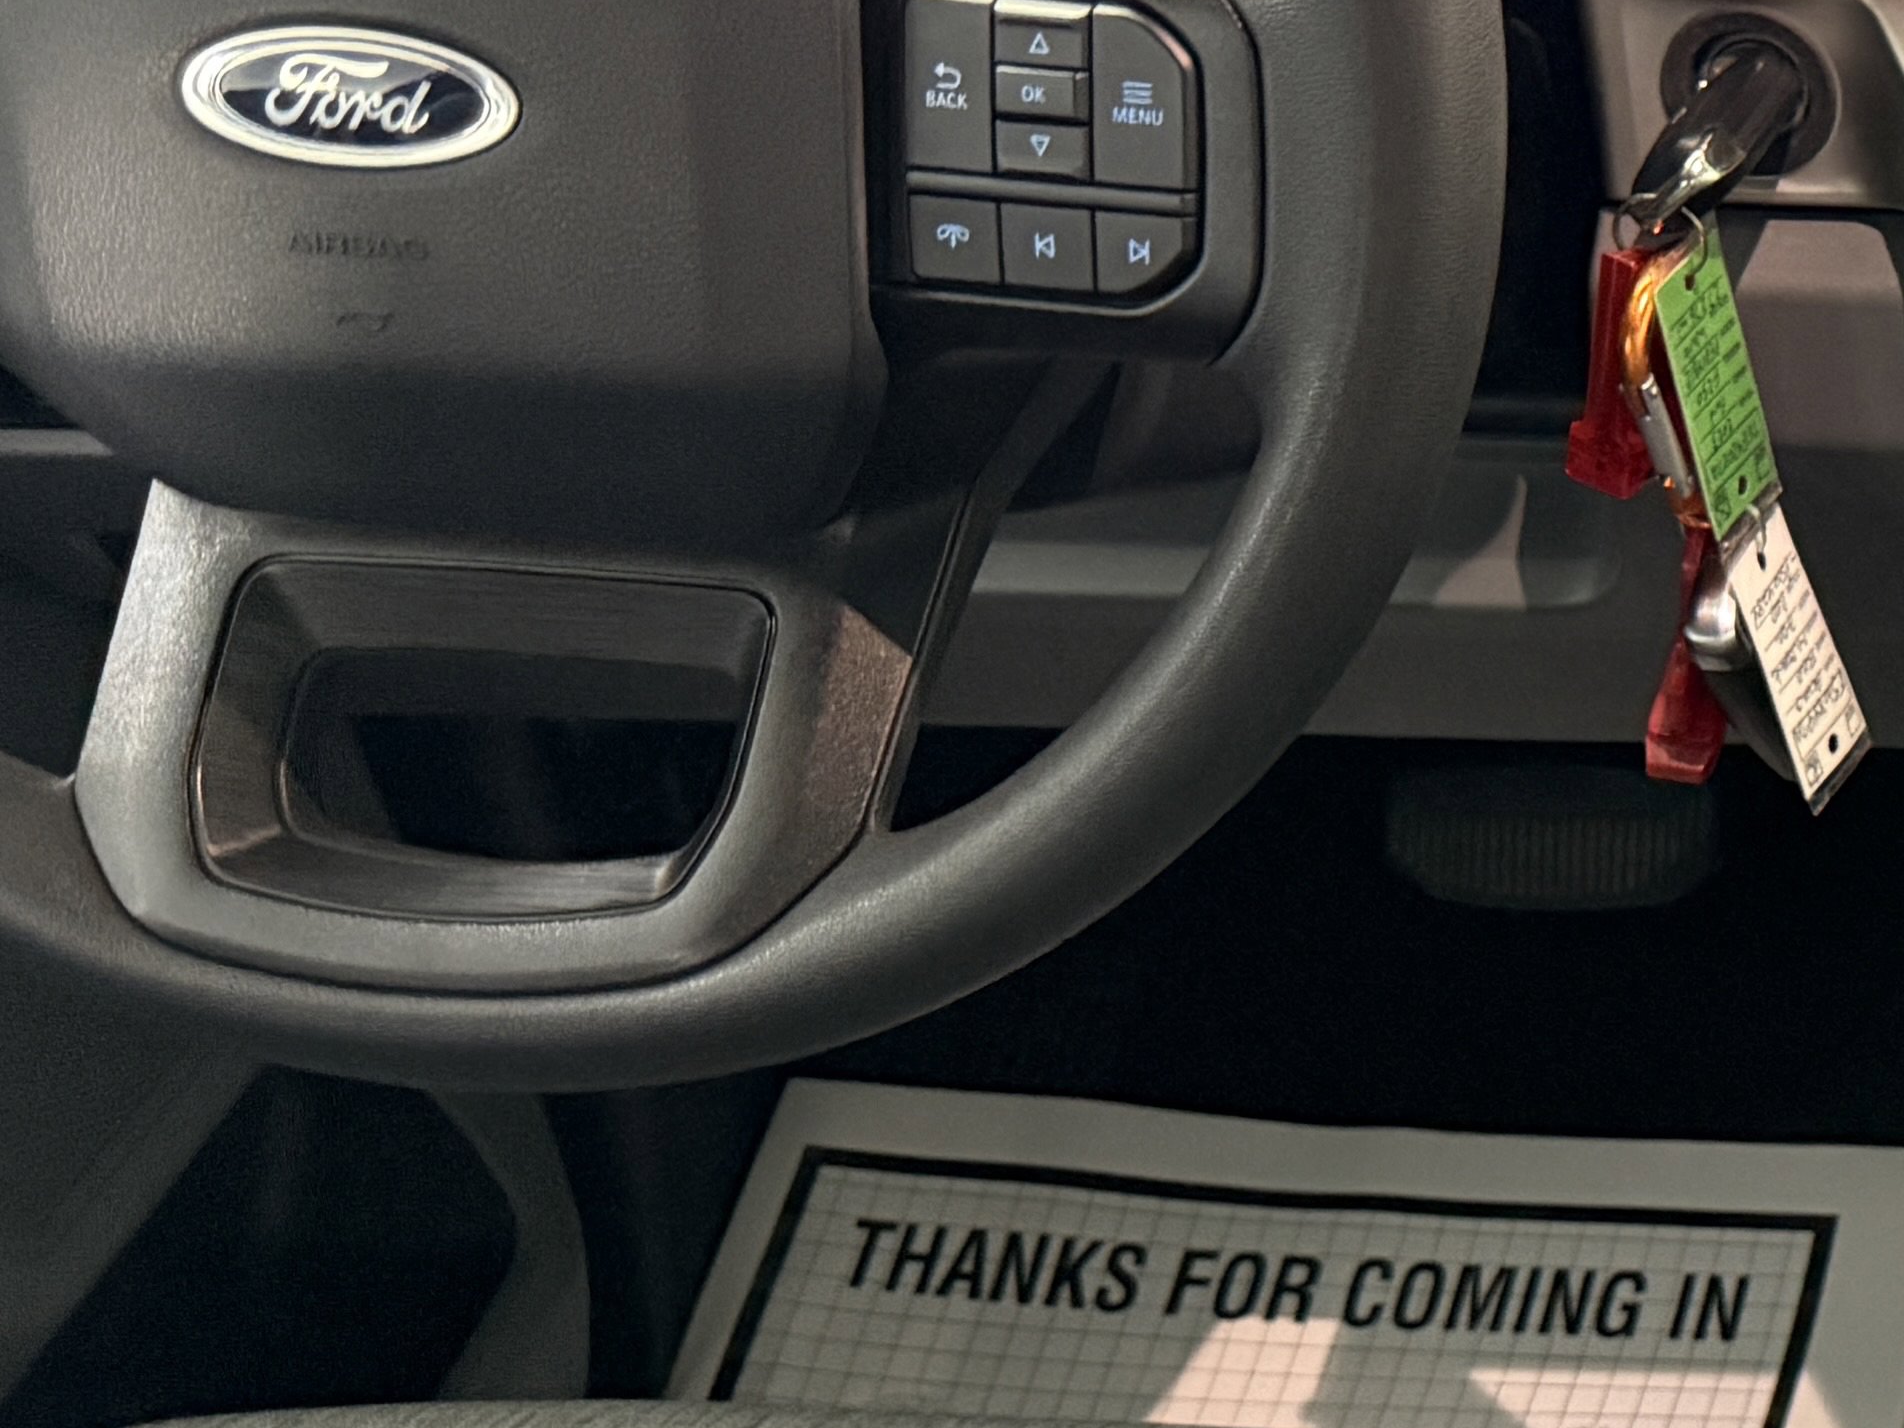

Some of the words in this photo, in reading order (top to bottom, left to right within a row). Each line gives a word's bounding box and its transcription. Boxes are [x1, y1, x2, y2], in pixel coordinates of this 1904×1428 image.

[264, 52, 431, 134] Ford
[925, 91, 968, 110] BACK
[1021, 85, 1046, 104] OK
[1112, 106, 1164, 126] MENU
[845, 1217, 1149, 1314] THANKS
[1165, 1249, 1323, 1321] FOR
[1341, 1257, 1653, 1338] COMING
[1668, 1274, 1750, 1343] IN
